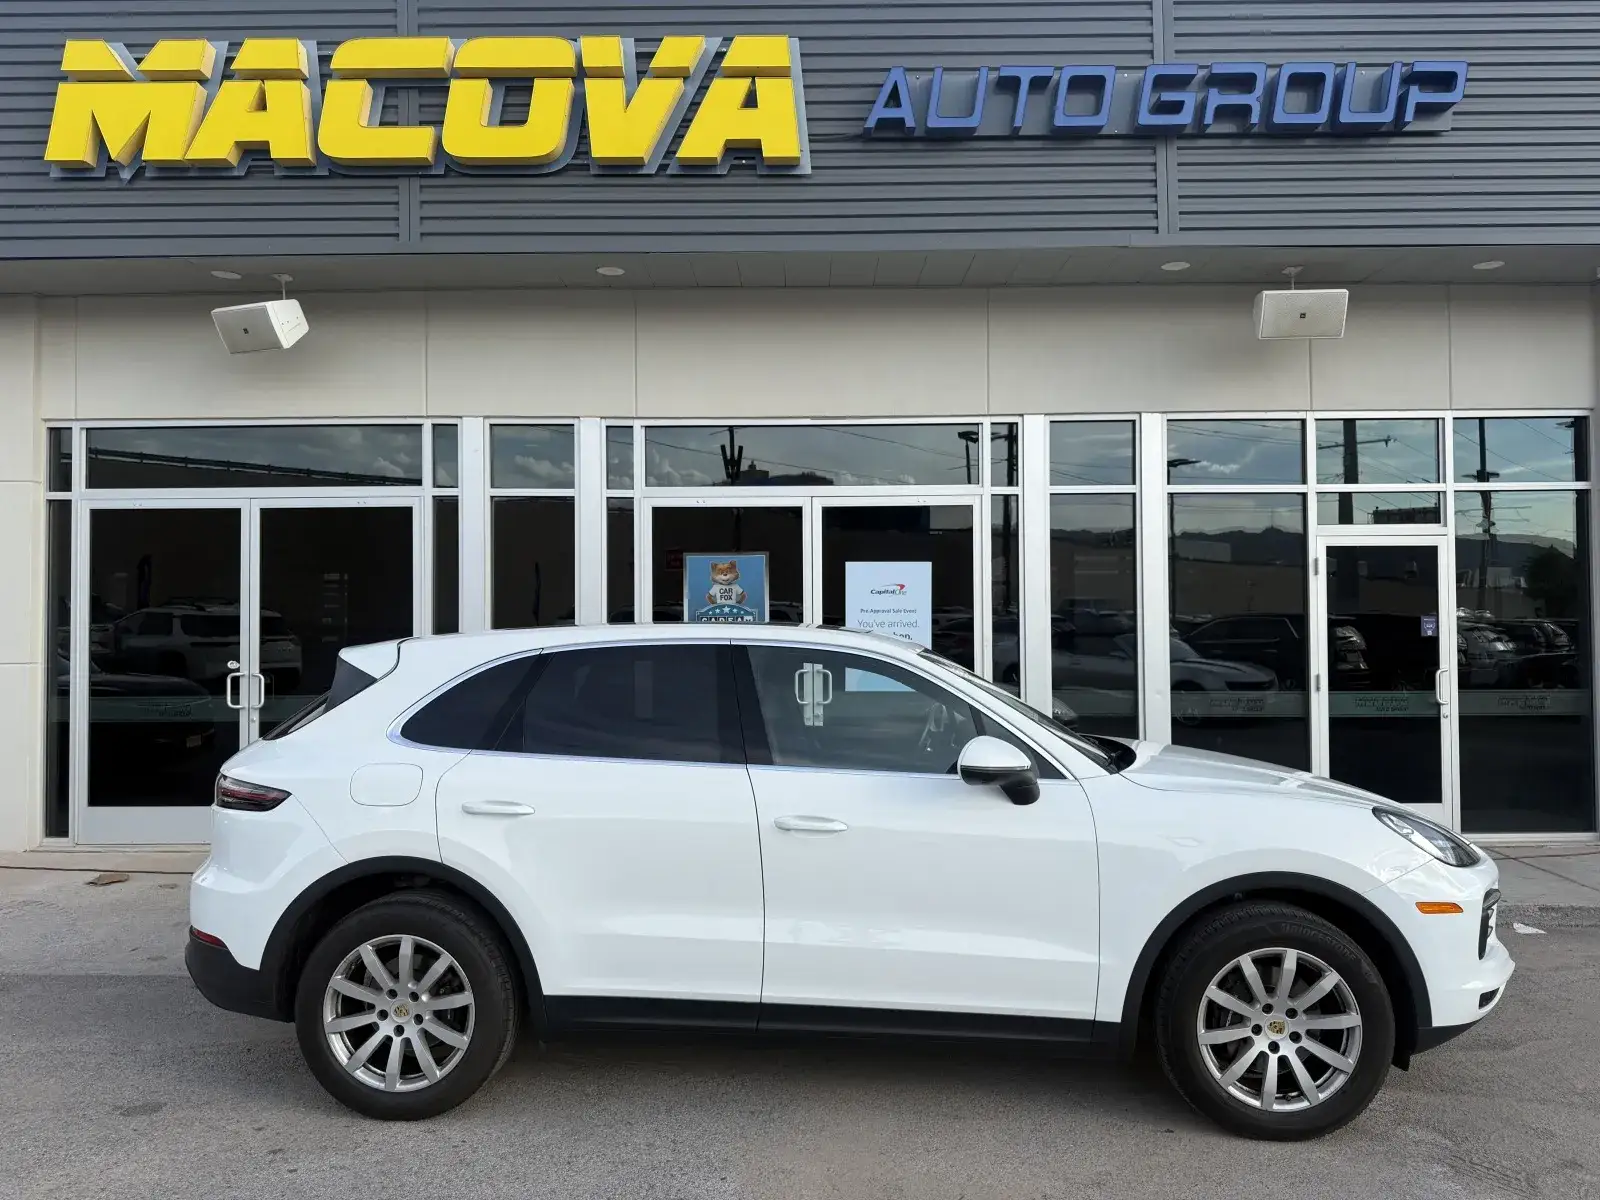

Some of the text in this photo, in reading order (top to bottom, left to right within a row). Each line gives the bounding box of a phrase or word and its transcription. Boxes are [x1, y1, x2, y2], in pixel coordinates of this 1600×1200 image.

[44, 34, 1468, 168] MACOVA AUTO GROUP
[719, 587, 734, 595] CAR
[857, 619, 920, 628] You've arrived.
